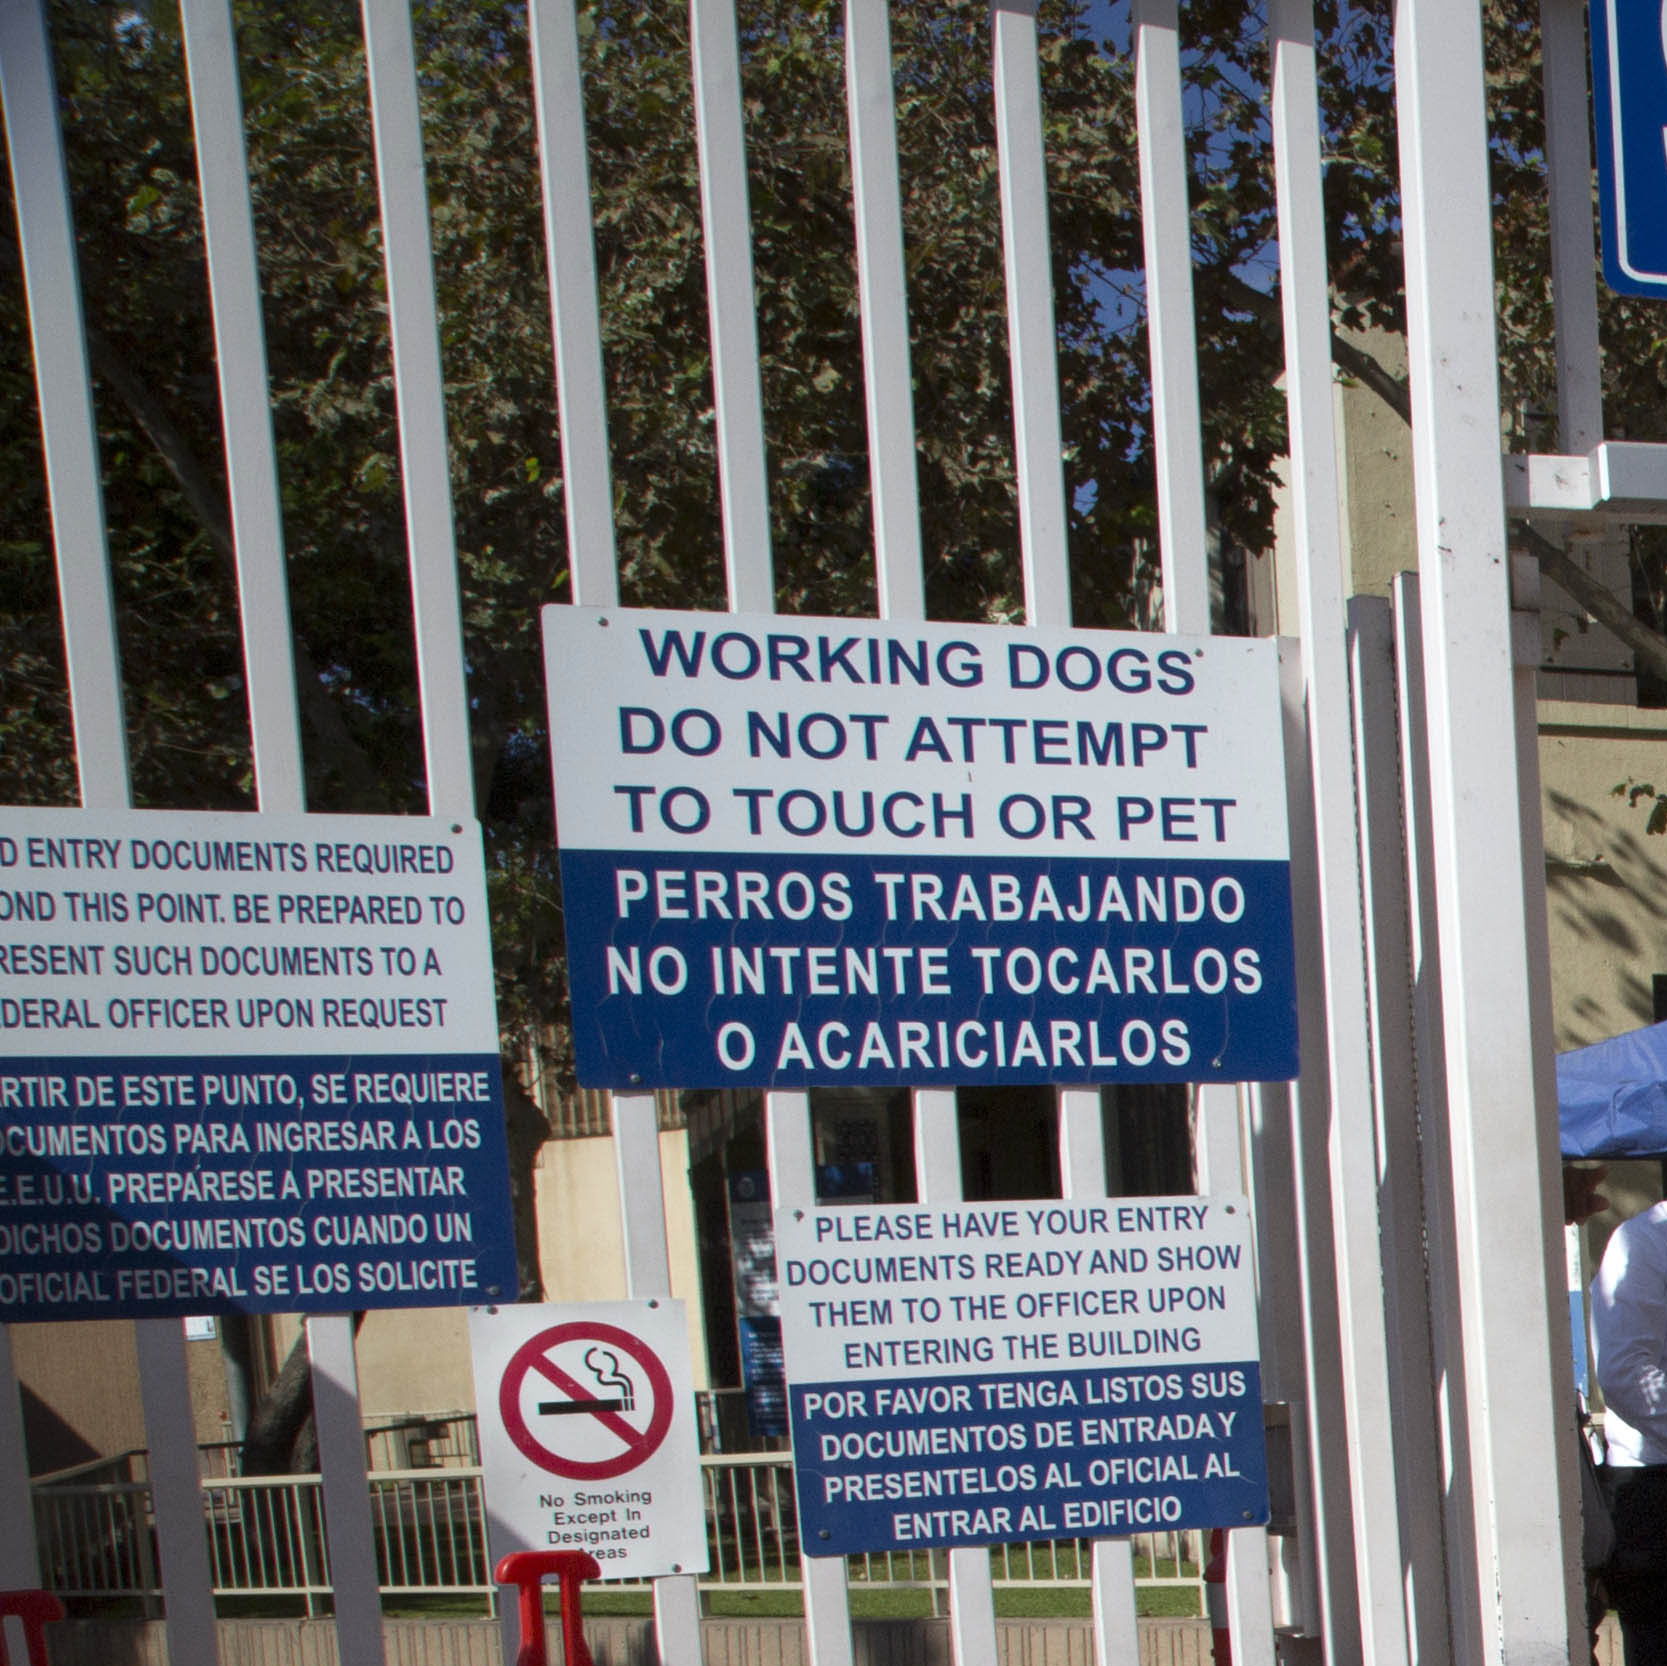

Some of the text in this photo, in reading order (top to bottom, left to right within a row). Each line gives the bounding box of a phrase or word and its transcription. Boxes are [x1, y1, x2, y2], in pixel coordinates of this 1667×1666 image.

[638, 628, 1195, 696] WORKING DOGS
[619, 706, 1208, 769] DO NOT ATTEMPT
[613, 785, 1237, 843] TO TOUCH OR PET
[27, 837, 121, 869] ENTRY
[130, 839, 308, 872] DOCUMENTS
[315, 843, 454, 875] REQUIRED
[0, 890, 465, 925] OND THIS POINT. BE PREPARED TO
[616, 869, 1245, 923] PERROS TRABAJANDO
[114, 945, 192, 976] SUCH
[200, 946, 373, 976] DOCUMENTS
[380, 947, 416, 976] TO
[423, 947, 442, 976] A
[606, 946, 1262, 995] NO INTENTE TOCARLOS
[0, 998, 448, 1029] DERAL OFFICER UPON REQUEST
[717, 1019, 1191, 1071] O ACARICIARLOS
[0, 1072, 491, 1109] RTIR DE ESTE PUNTO, SE REQUIERE
[0, 1119, 481, 1156] CUMENTOS PARA INGRESAR A LOS
[281, 1169, 301, 1200] A
[307, 1166, 467, 1199] PRESENTAR
[112, 1216, 306, 1254] DOCUMENTOS
[313, 1213, 428, 1246] CUANDO
[435, 1212, 472, 1243] UN
[815, 1205, 1209, 1243] PLEASE HAVE YOUR ENTRY
[0, 1259, 478, 1305] OFICIAL FEDERAL SE LOS SOLICITE
[786, 1244, 1241, 1287] DOCUMENTS READY AND SHOW
[808, 1285, 1225, 1327] THEM TO THE OFFICER UPON
[844, 1327, 1201, 1369] ENTERING THE BUILDING
[804, 1370, 1246, 1420] POR FAVOR TENGA LISTOS SUS
[821, 1411, 1236, 1461] DOCUMENTOS DE ENTRADA Y
[824, 1452, 1241, 1503] PRESENTELOS AL OFICIAL AL
[540, 1490, 652, 1508] No Smoking
[554, 1508, 641, 1526] Except In
[894, 1495, 1182, 1540] ENTRAR AL EDIFICIO
[548, 1525, 650, 1544] Designated
[580, 1547, 627, 1560] reas
